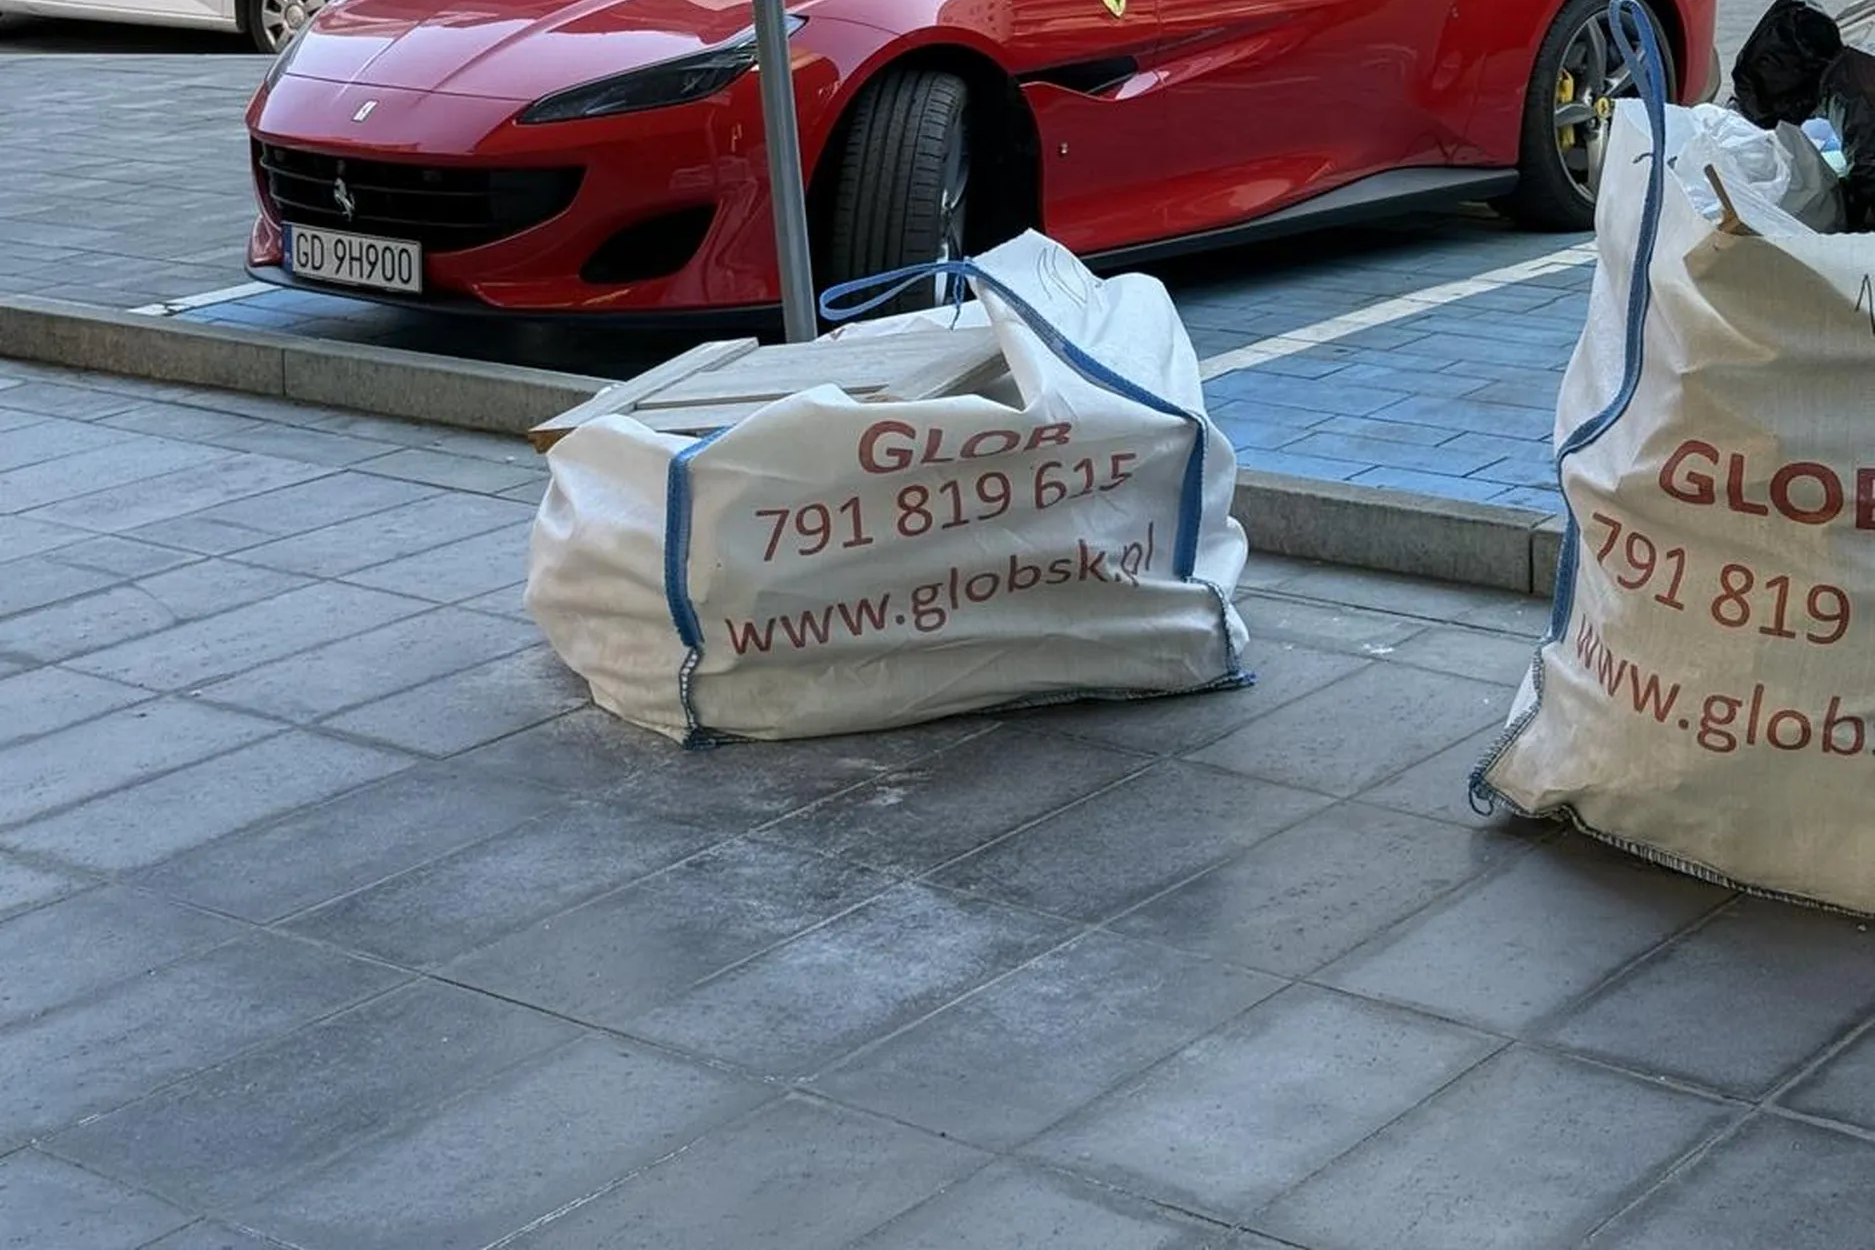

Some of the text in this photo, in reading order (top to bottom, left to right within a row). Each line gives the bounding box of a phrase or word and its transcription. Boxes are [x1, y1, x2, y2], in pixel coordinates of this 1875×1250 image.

[296, 233, 412, 285] GD 9H900
[755, 452, 1138, 562] 791 819 615
[724, 521, 1155, 656] www.globsk.pl
[1591, 512, 1850, 645] 791 819
[1574, 613, 1875, 756] www.glob
